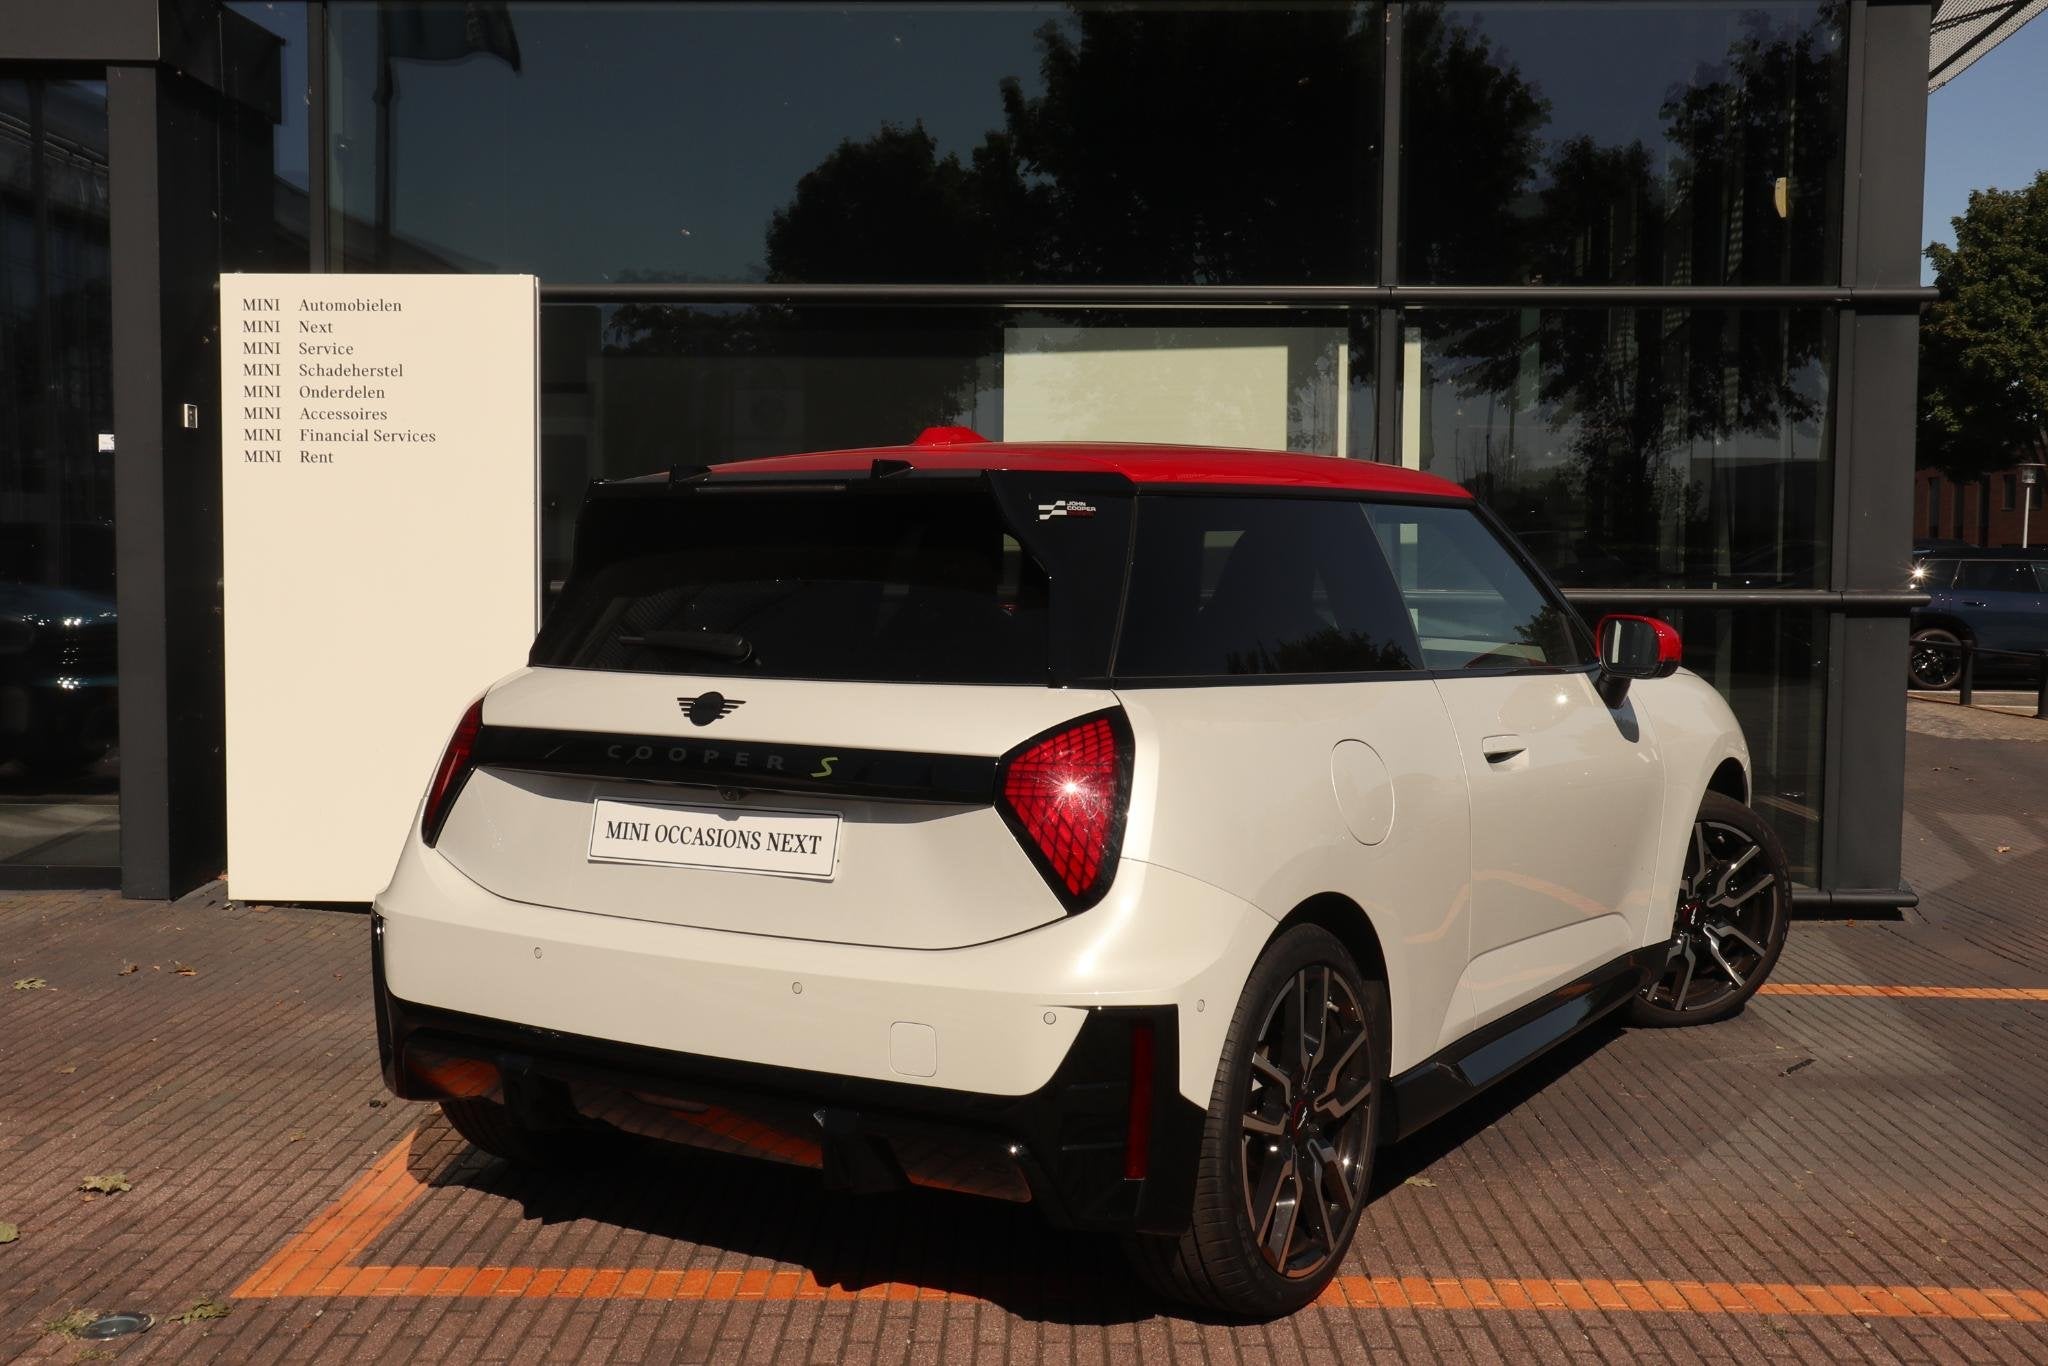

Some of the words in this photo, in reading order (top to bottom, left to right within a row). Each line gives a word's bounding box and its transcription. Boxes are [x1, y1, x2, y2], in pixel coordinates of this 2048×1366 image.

[242, 298, 281, 312] MINI
[299, 298, 402, 312] Automobielen
[242, 320, 281, 333] MINI
[299, 320, 333, 334] Next
[243, 342, 281, 355] MINI
[299, 342, 354, 356] Service
[243, 363, 281, 377] MINI
[299, 363, 403, 377] Schadeherstel
[243, 385, 281, 398] MINI
[299, 385, 385, 399] Onderdelen
[244, 407, 281, 420] MINI
[300, 407, 388, 421] Accessoires
[244, 428, 281, 442] MINI
[300, 428, 369, 443] Financial
[373, 429, 436, 443] Services
[244, 450, 281, 463] MINI
[300, 450, 334, 464] Rent
[607, 744, 784, 770] COOPER
[808, 755, 840, 779] S
[605, 820, 651, 842] MINI
[654, 824, 762, 851] OCCASIONS
[766, 832, 822, 855] NEXT
